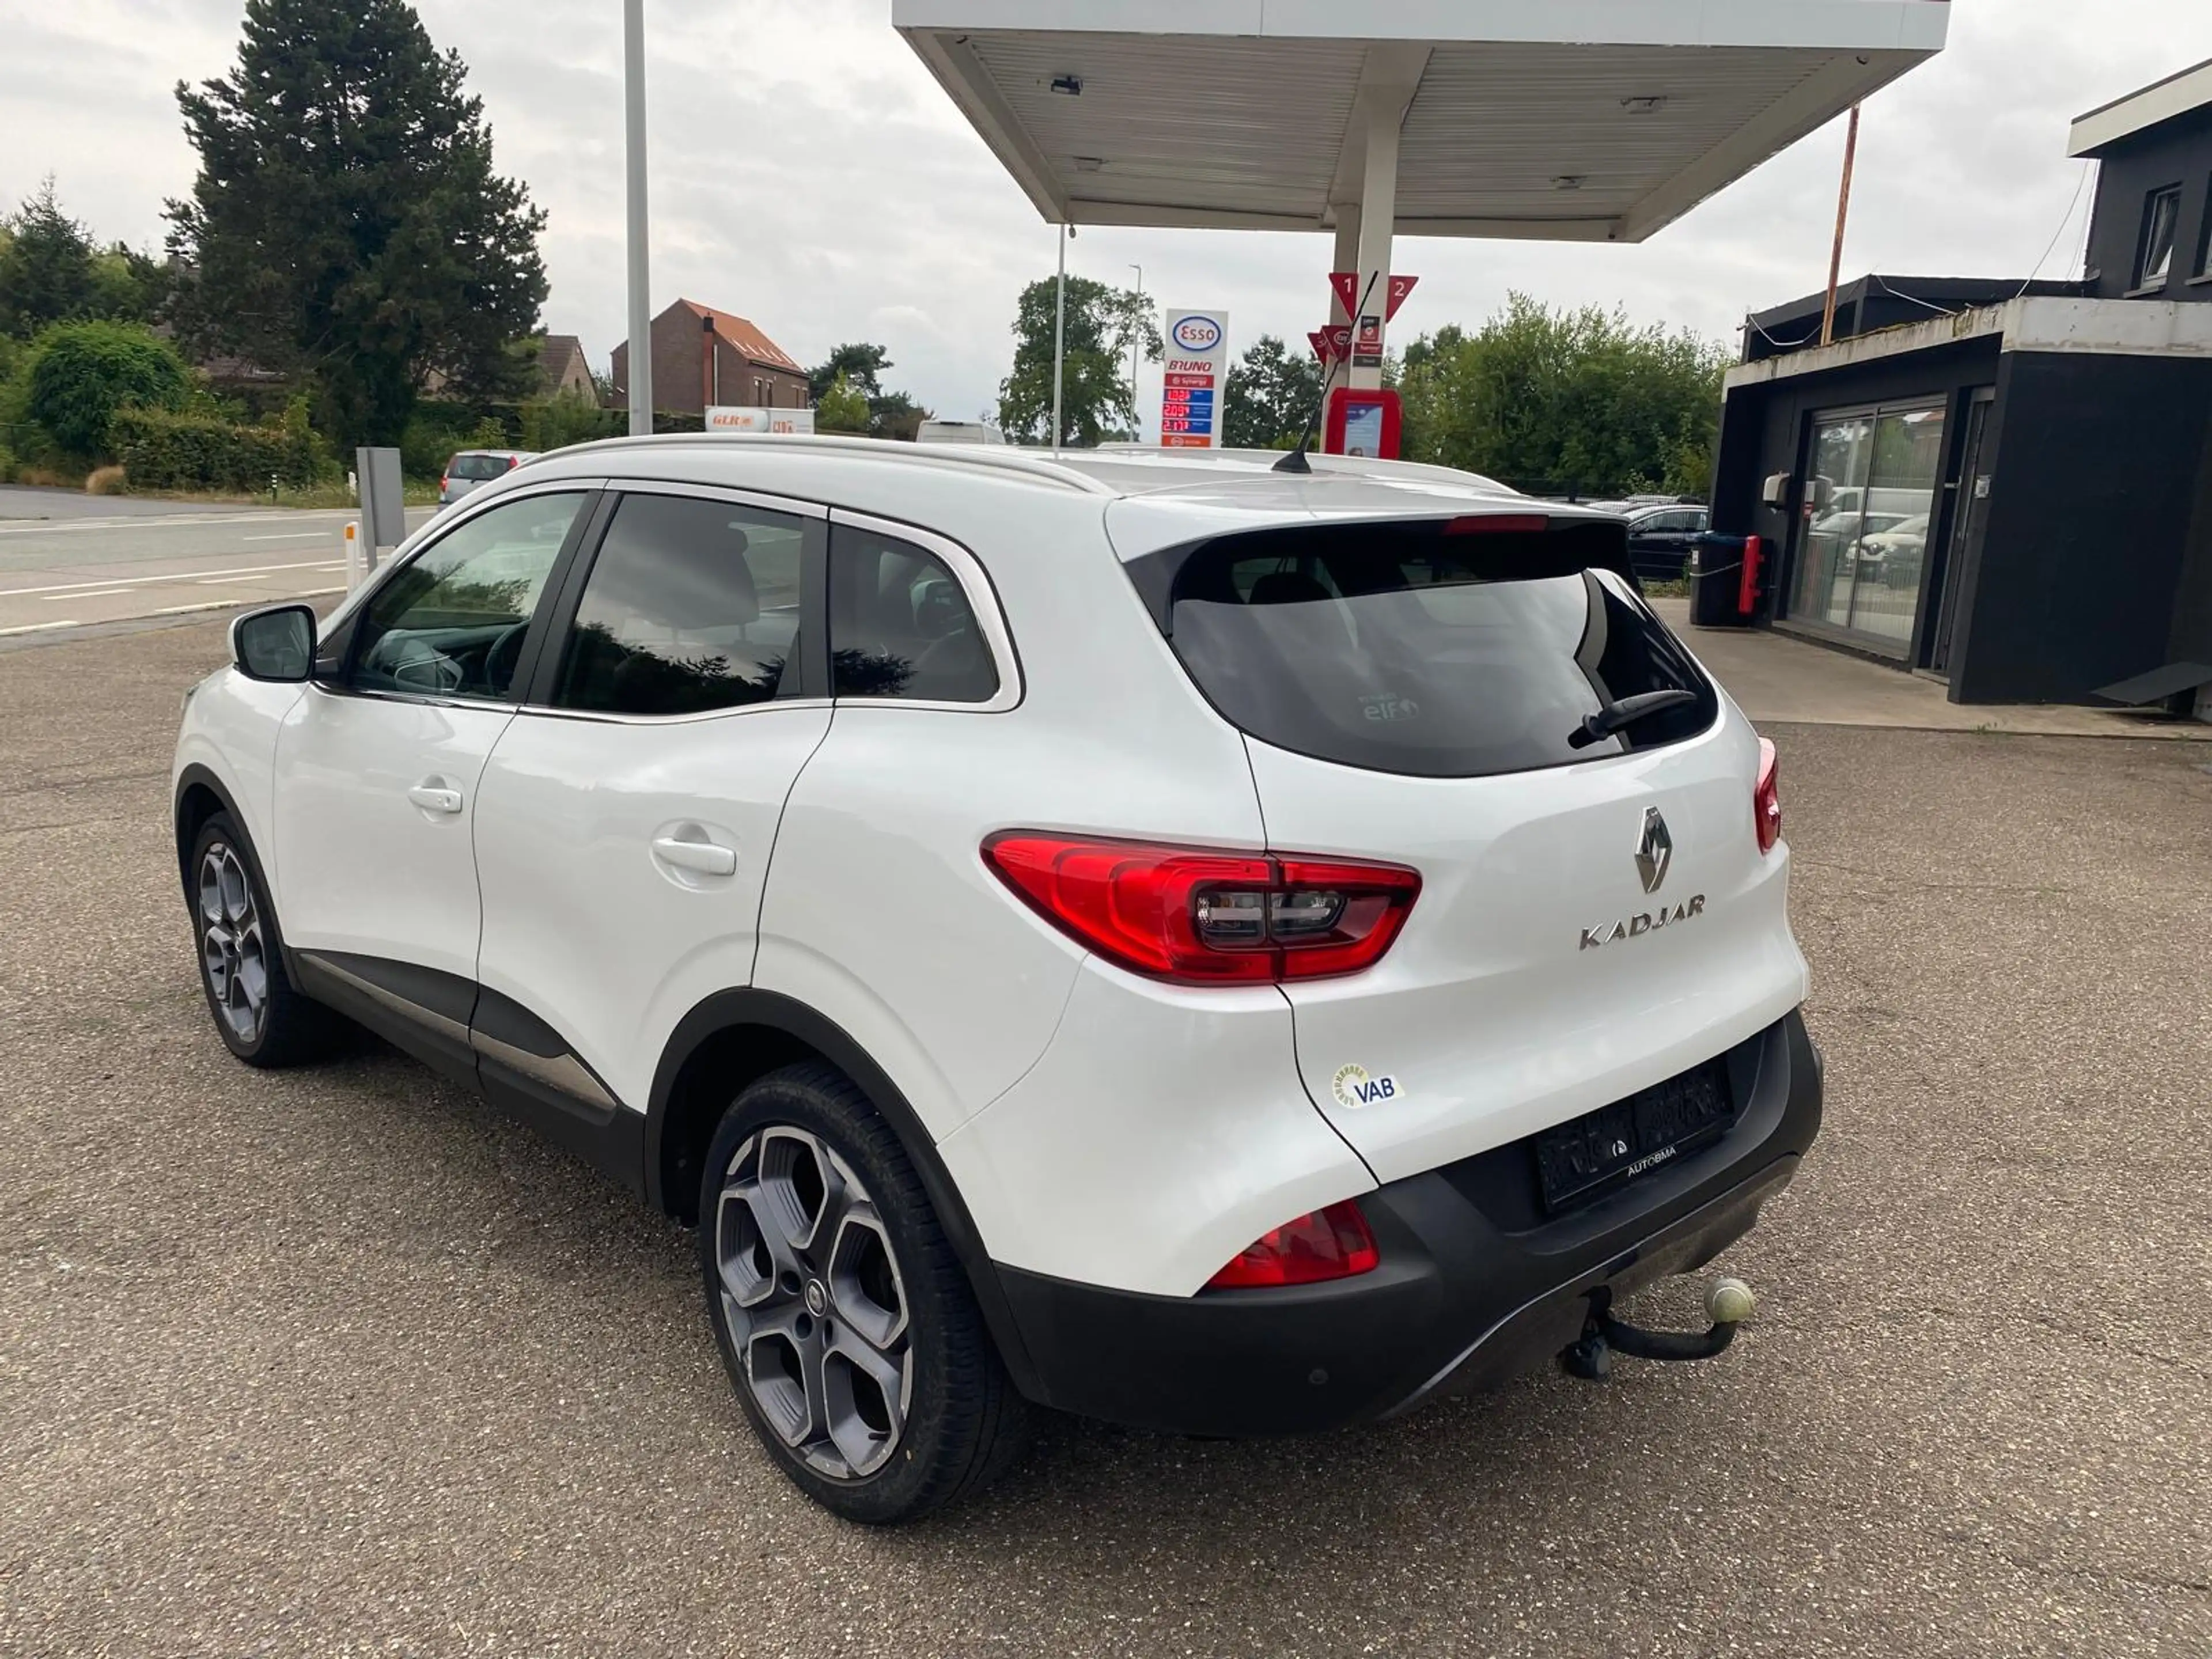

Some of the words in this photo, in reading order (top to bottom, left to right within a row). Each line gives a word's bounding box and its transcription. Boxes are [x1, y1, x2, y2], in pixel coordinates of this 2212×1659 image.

[1344, 277, 1351, 293] 1
[1395, 281, 1404, 297] 2
[1181, 325, 1214, 342] Esso
[1168, 360, 1212, 372] BRUNO
[1579, 894, 1705, 951] KADJAR
[1354, 1078, 1395, 1104] VAB
